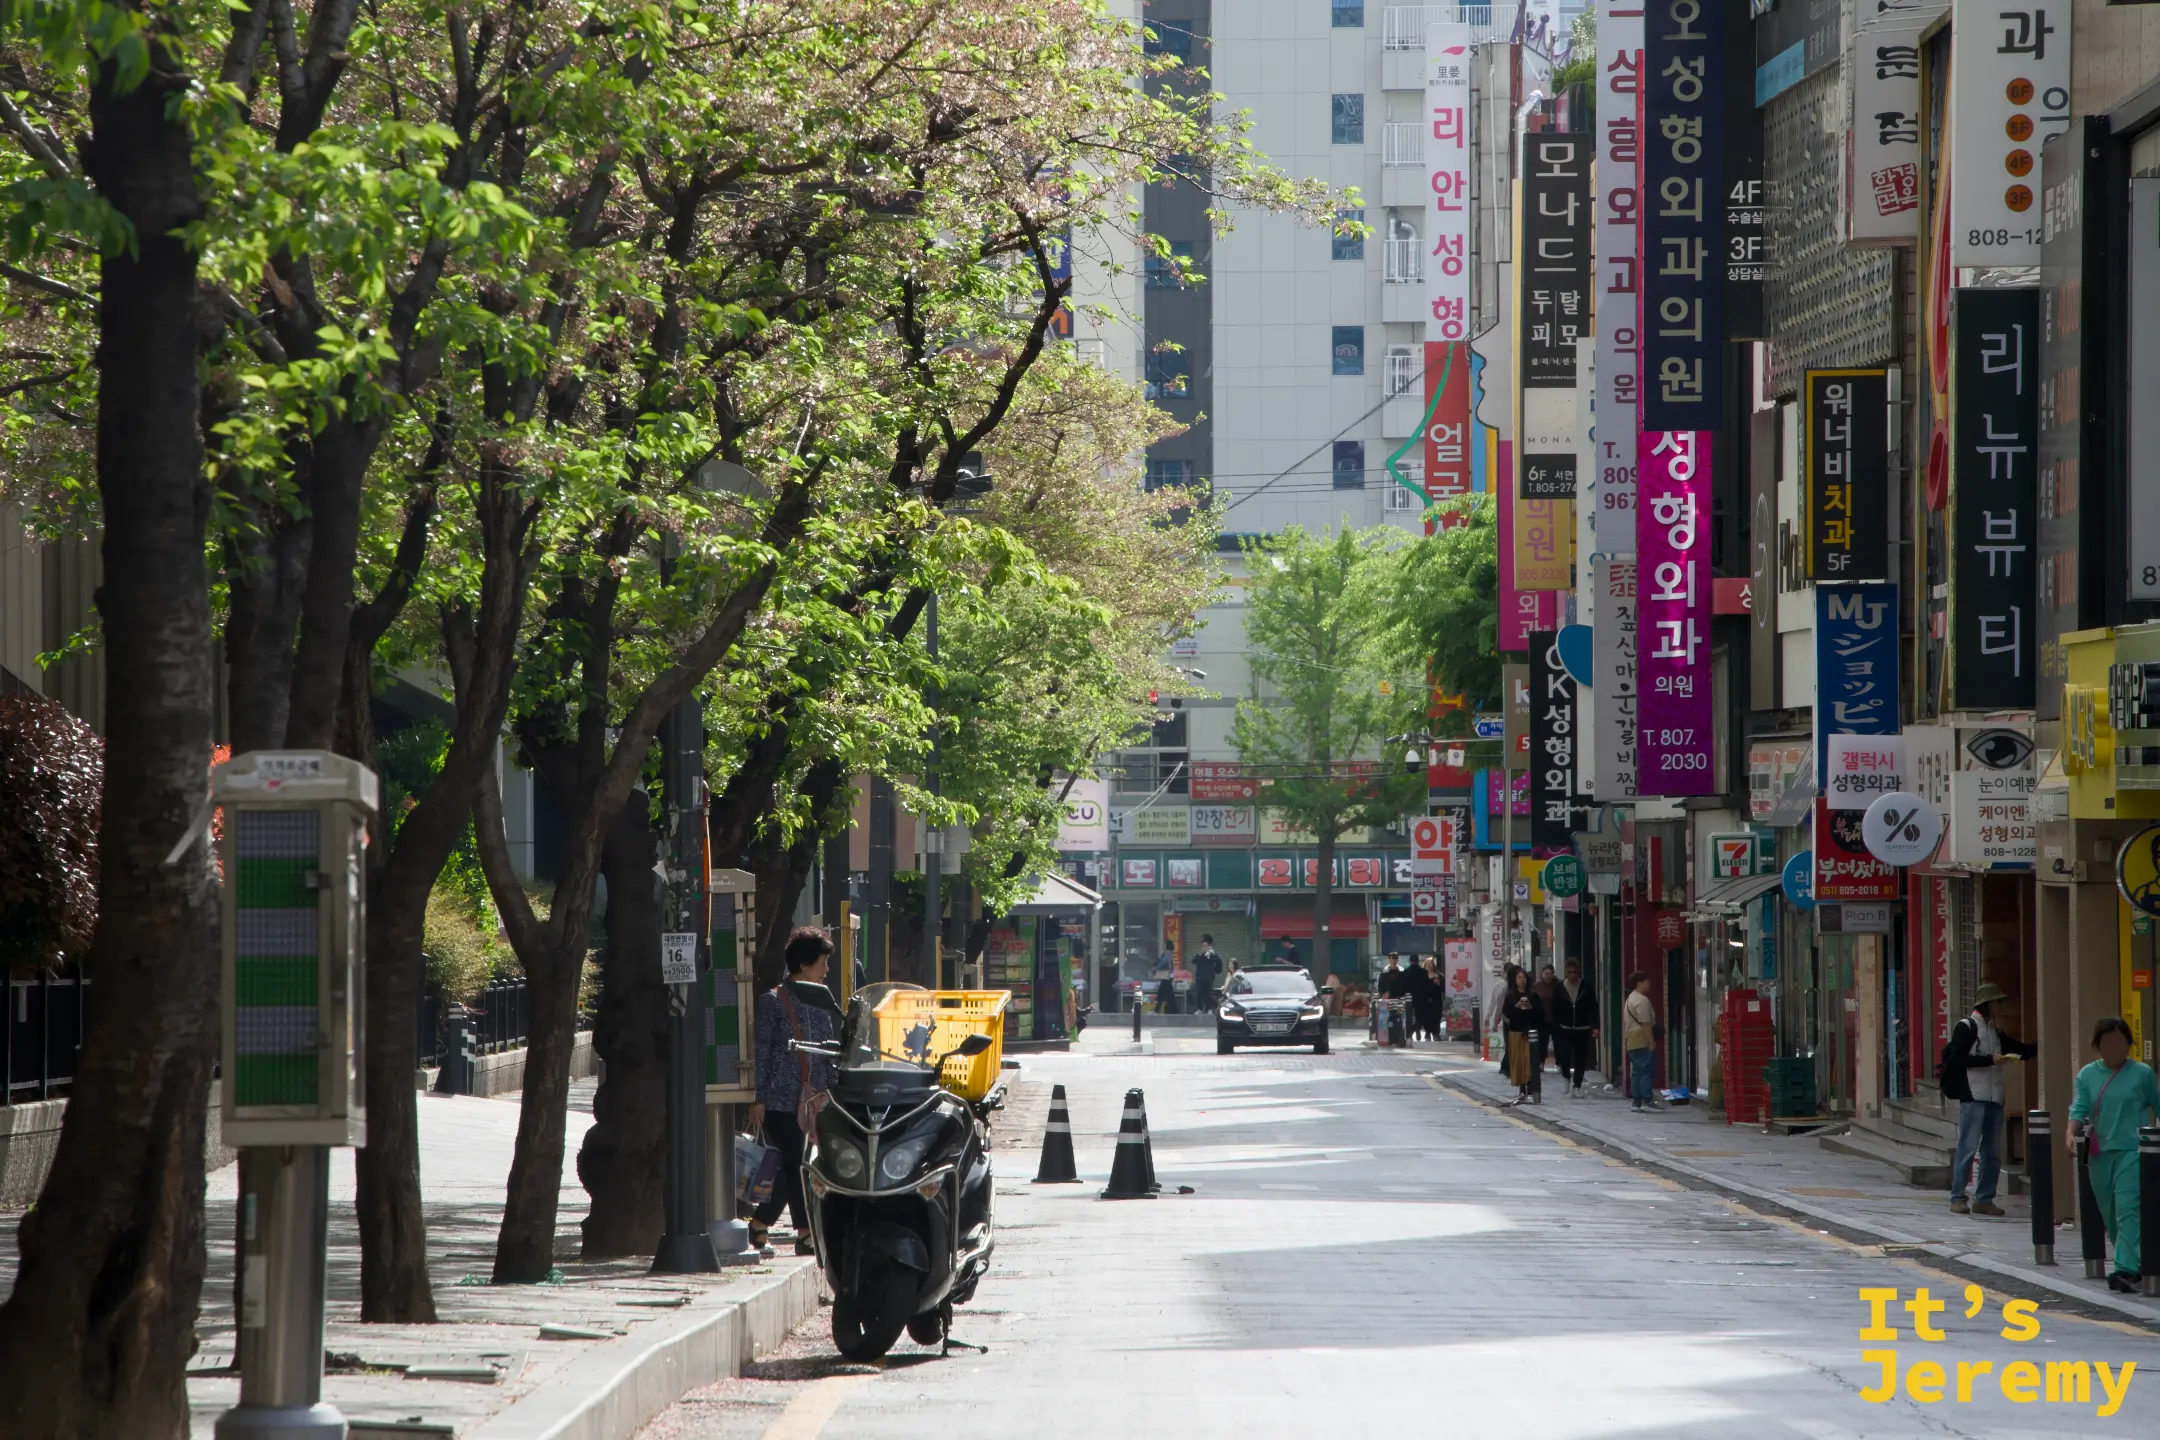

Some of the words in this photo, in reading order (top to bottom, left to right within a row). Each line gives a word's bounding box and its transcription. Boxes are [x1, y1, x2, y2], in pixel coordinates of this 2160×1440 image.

[1997, 10, 2054, 59] 과
[2011, 86, 2029, 97] 6F
[2010, 122, 2029, 133] 5F
[2010, 157, 2029, 168] 4F
[1659, 0, 1709, 402] 오성형외과의원
[1730, 180, 1762, 204] 4F
[2010, 192, 2029, 204] 3F
[1534, 142, 1580, 272] 모나드
[1431, 107, 1467, 340] 리안성형
[1730, 236, 1762, 260] 3F
[1528, 466, 1547, 481] 6F
[1554, 470, 1577, 481] 서면
[1974, 324, 2027, 677] 리뉴뷰티
[1827, 554, 1852, 571] 5F
[1828, 594, 1888, 629] MJ
[1654, 675, 1693, 698] 의원
[1831, 634, 1885, 736] ショッピ
[1660, 752, 1708, 771] 2030
[1841, 751, 1895, 771] 갤럭시
[1832, 774, 1902, 793] 성형외과
[1195, 808, 1251, 829] 한창전기
[1414, 820, 1453, 873] 약
[1984, 847, 2037, 857] 808-1228
[1819, 858, 1895, 883] 부대찌개
[1840, 885, 1879, 895] 805-2018
[1415, 892, 1446, 923] 약
[1845, 910, 1874, 921] Plan
[1878, 910, 1886, 921] B
[667, 949, 683, 963] 16
[671, 967, 691, 975] 3900
